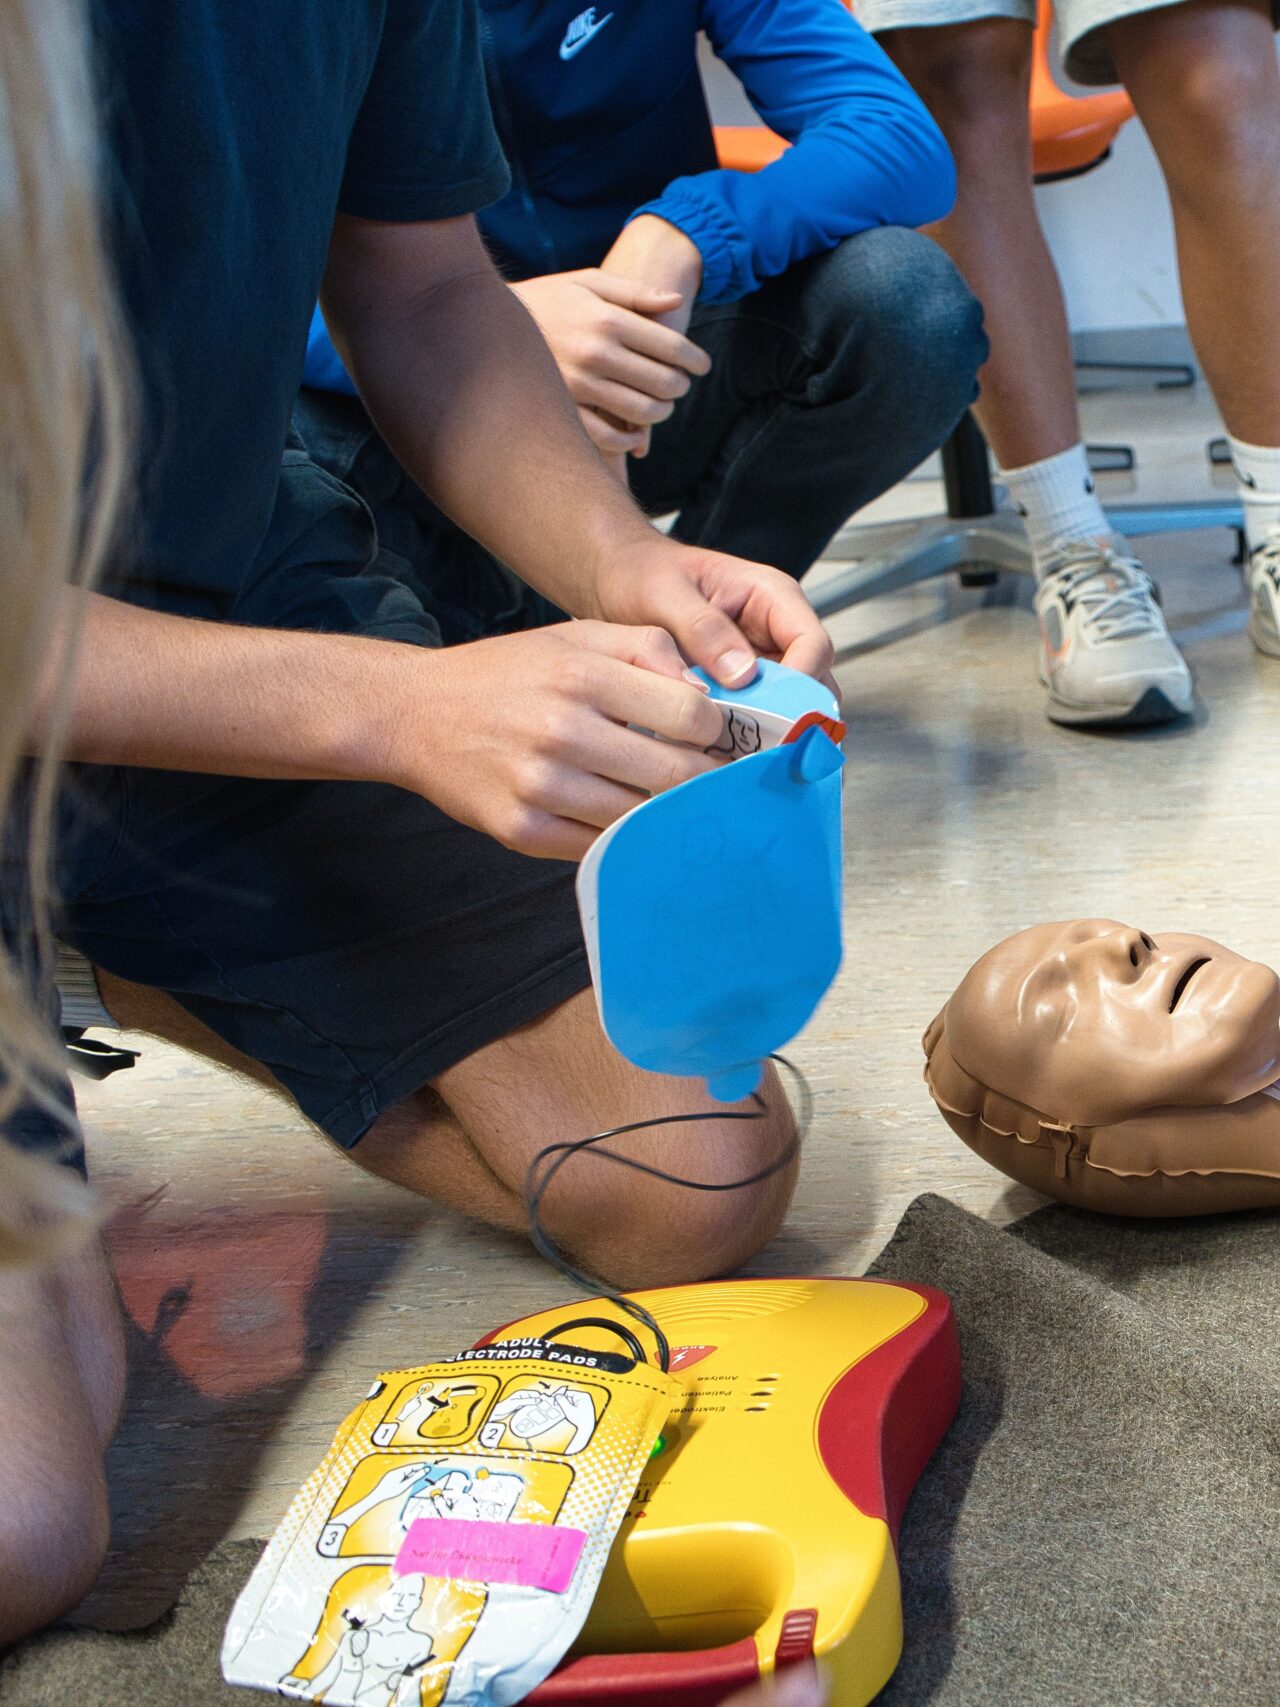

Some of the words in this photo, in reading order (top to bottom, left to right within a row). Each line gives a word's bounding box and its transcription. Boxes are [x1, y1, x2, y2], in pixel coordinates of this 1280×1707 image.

[566, 6, 596, 44] NIKE
[495, 1337, 556, 1349] ADULT
[547, 1351, 598, 1367] PADS
[378, 1428, 389, 1440] 1
[486, 1428, 499, 1440] 2
[325, 1531, 339, 1546] 3
